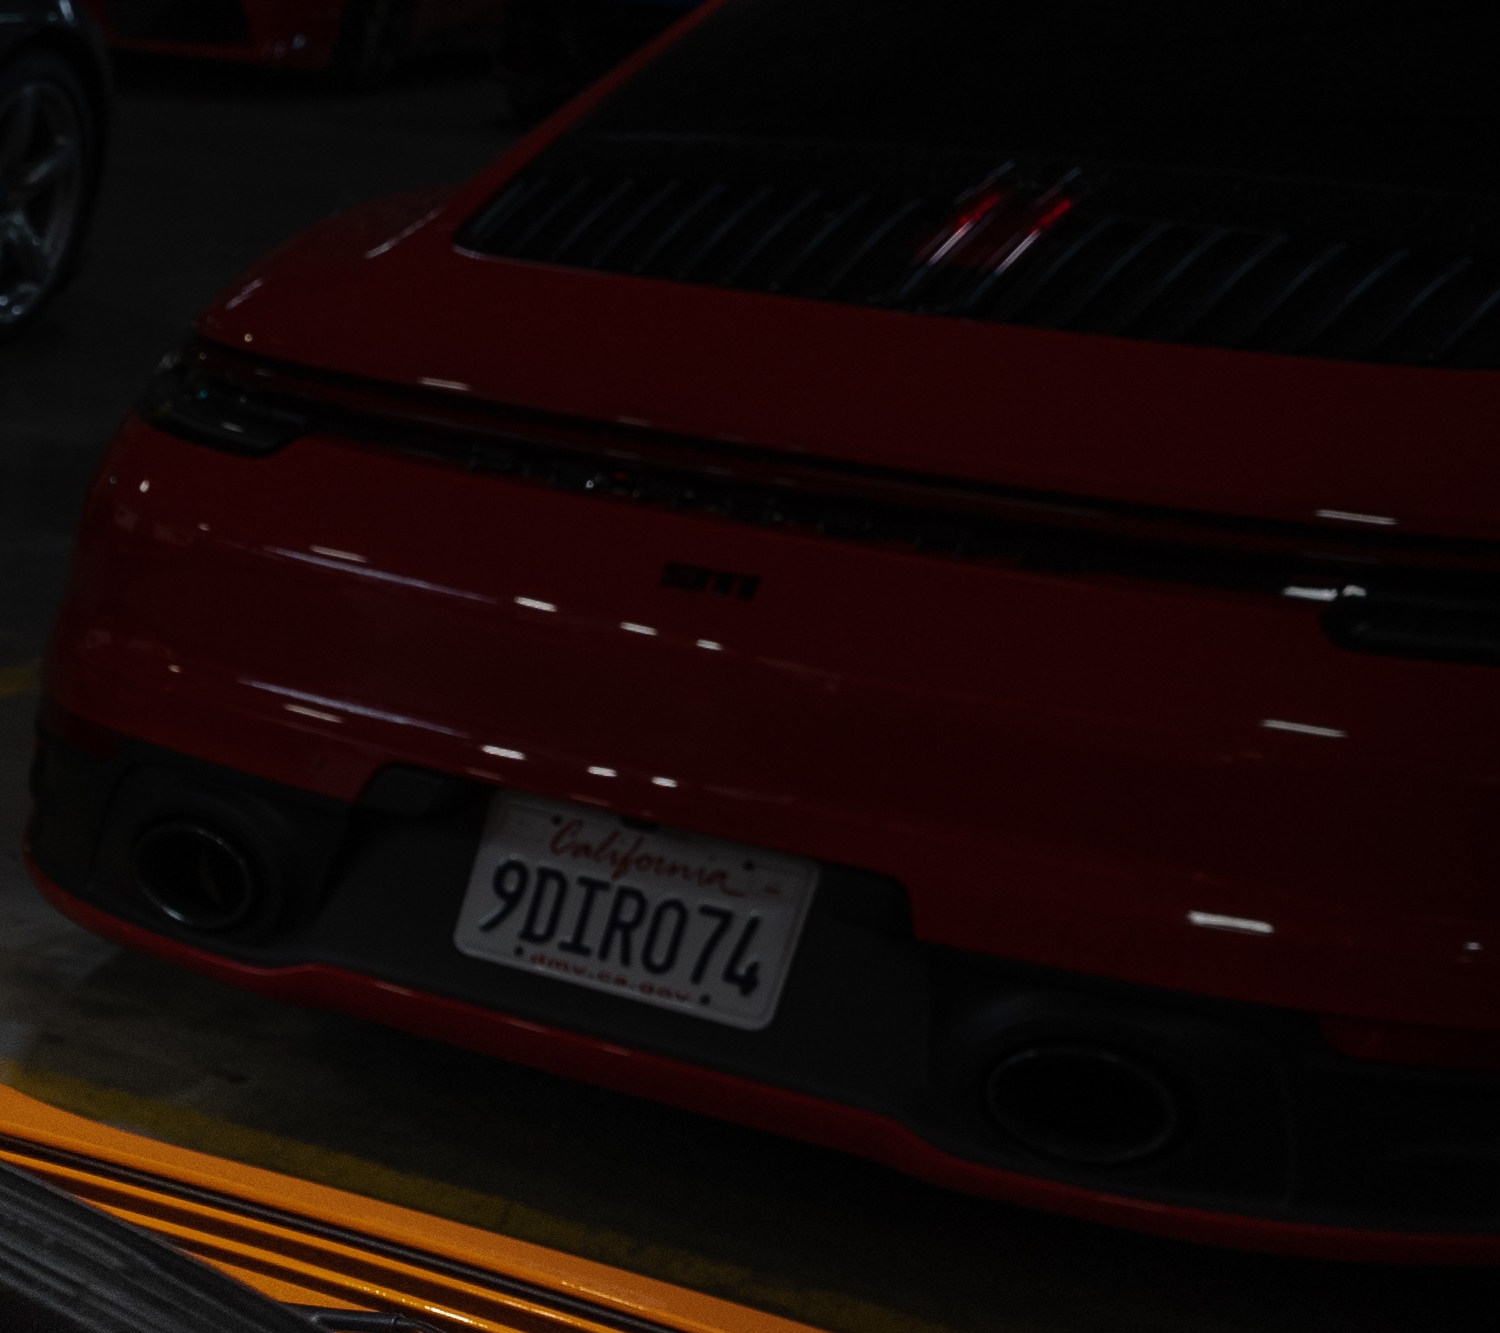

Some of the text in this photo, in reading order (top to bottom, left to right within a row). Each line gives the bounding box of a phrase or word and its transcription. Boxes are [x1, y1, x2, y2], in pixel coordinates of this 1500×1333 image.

[550, 820, 744, 898] California
[479, 861, 761, 996] 9DIR074
[531, 953, 691, 1002] dmv.ca.gov
